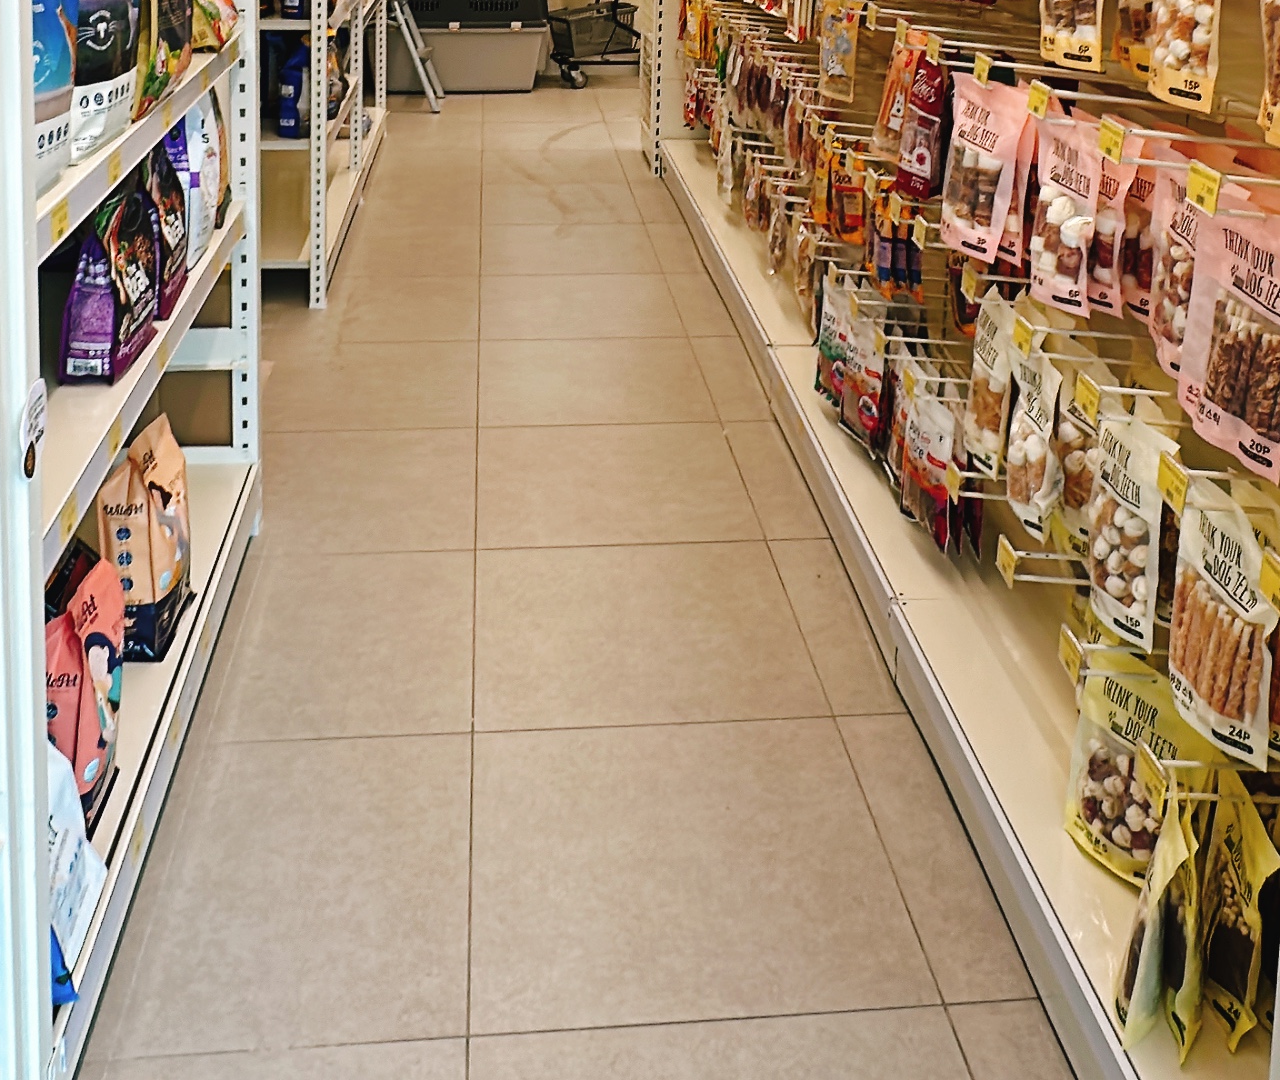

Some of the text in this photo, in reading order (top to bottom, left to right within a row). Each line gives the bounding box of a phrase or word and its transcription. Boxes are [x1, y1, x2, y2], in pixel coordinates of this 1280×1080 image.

[1078, 44, 1090, 55] 6P
[1183, 79, 1201, 92] 15P
[1222, 227, 1276, 278] THINK YOUR
[1243, 268, 1265, 300] DOG
[1069, 289, 1081, 300] 6P
[1249, 438, 1271, 456] 20P
[1220, 526, 1244, 570] YOUR
[1212, 555, 1233, 588] DOG
[1124, 615, 1141, 629] 15P
[1102, 675, 1159, 730] THINK YOUR
[1228, 724, 1251, 742] 24P
